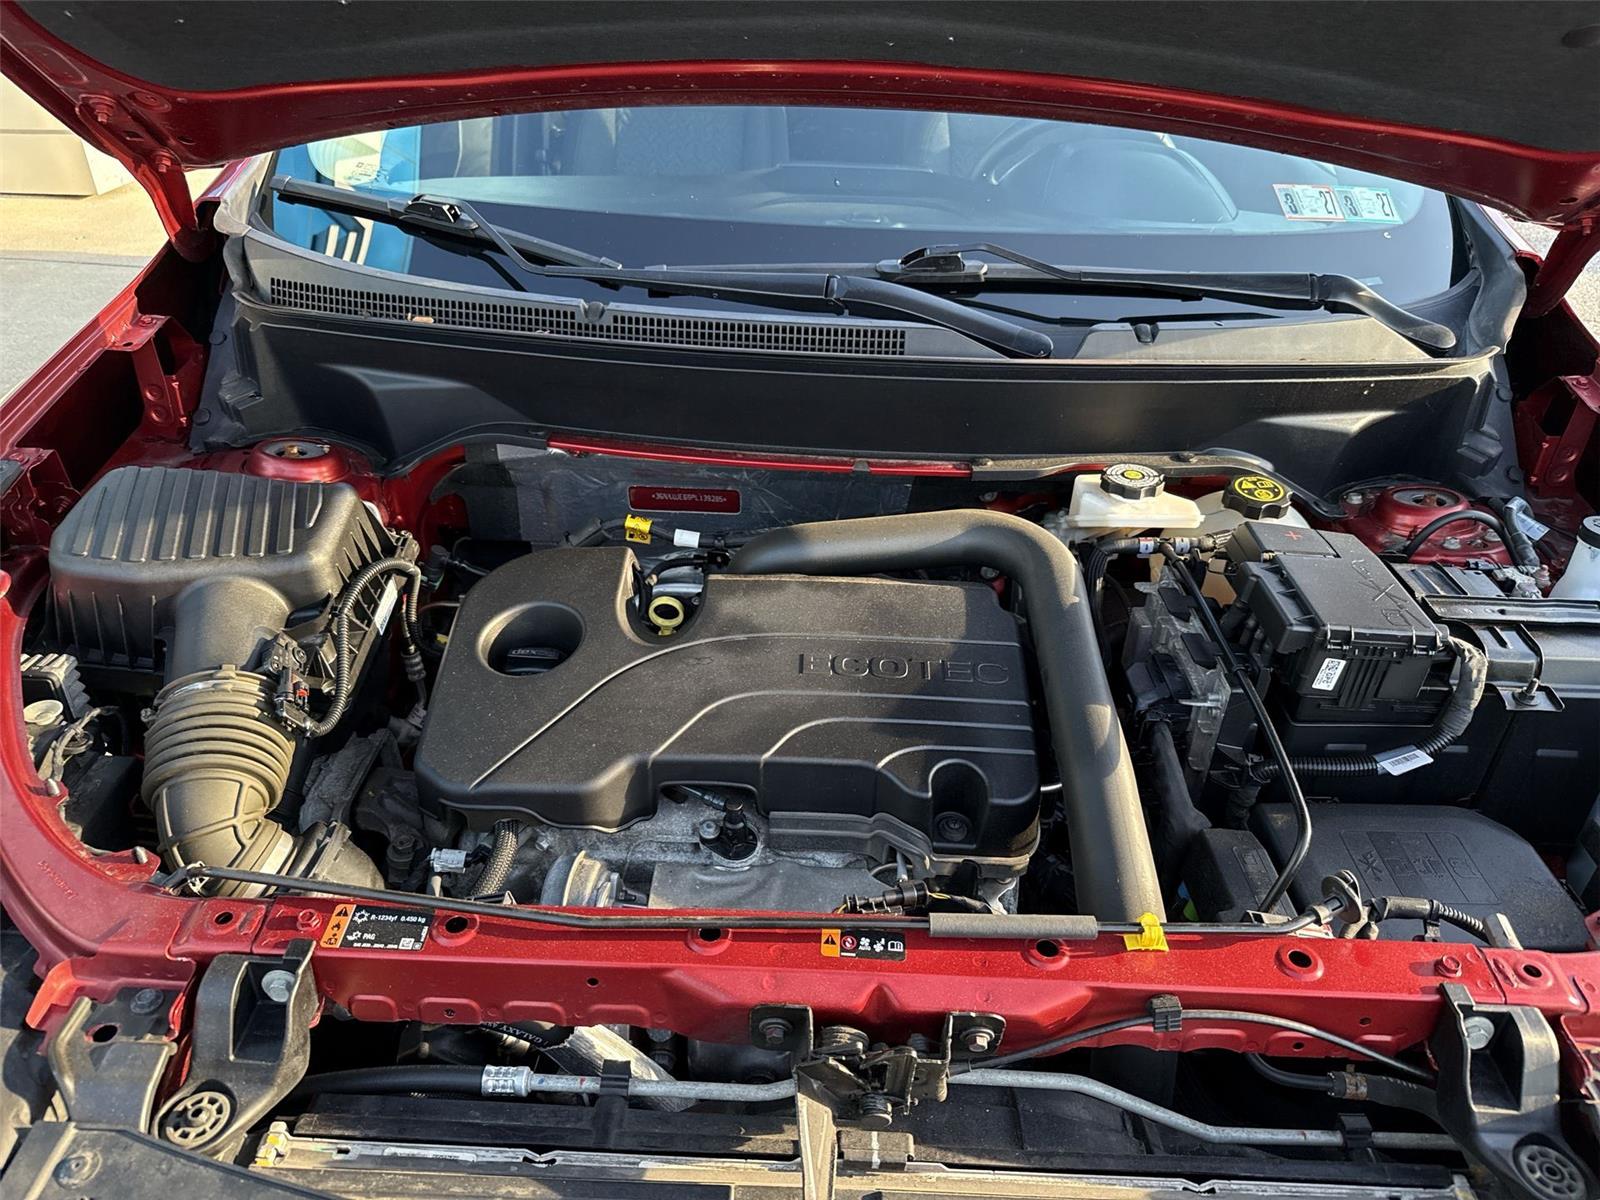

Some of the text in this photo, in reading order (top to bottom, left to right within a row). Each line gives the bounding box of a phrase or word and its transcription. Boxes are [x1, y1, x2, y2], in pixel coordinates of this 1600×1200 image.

[1284, 190, 1337, 216] 3 27
[1343, 192, 1395, 217] 3 27
[799, 653, 1009, 685] ECOTEC
[370, 915, 398, 923] R-1234yf
[501, 1025, 543, 1044] GALAXY
